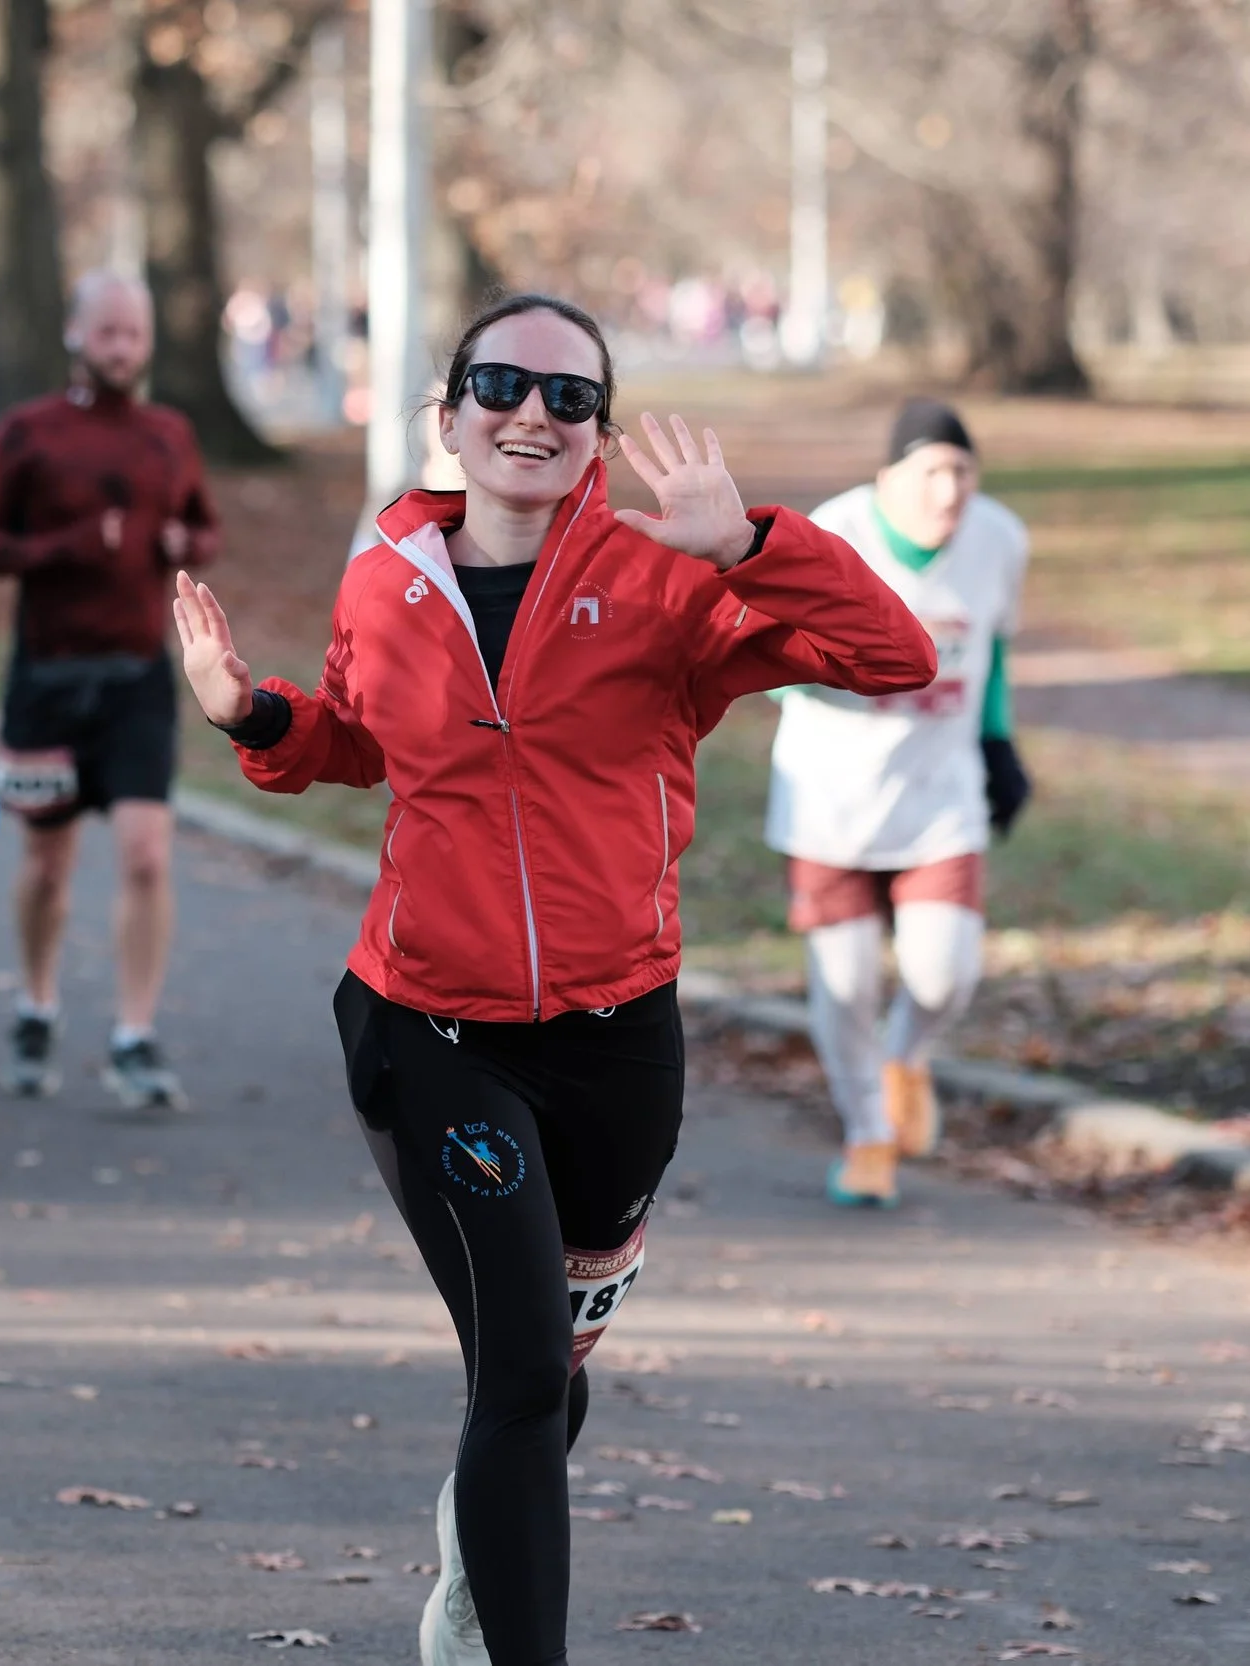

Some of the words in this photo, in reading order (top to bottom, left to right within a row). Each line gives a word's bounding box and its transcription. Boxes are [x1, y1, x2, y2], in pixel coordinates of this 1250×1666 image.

[496, 1128, 519, 1150] NEW
[441, 1145, 490, 1197] MAATHON
[516, 1151, 526, 1182] YORK
[495, 1181, 519, 1197] CITY
[571, 1269, 588, 1277] FOR
[578, 1254, 625, 1272] TURKEY
